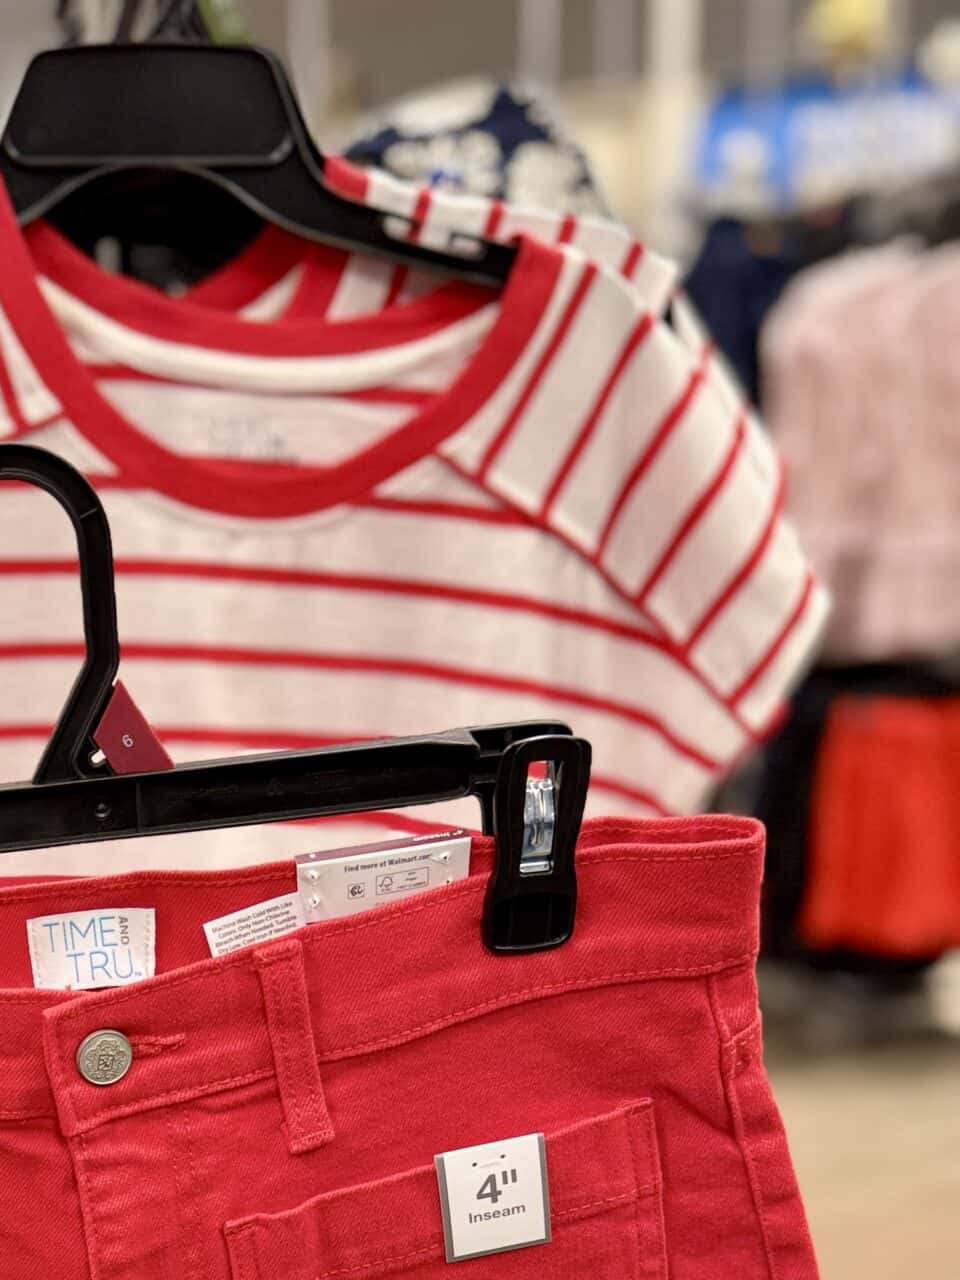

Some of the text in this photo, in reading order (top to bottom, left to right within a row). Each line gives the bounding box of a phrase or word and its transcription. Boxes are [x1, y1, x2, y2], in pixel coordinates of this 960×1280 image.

[121, 734, 134, 748] 6
[344, 864, 359, 873] Find
[360, 862, 378, 871] more
[379, 860, 387, 869] at
[118, 916, 130, 945] AND
[212, 920, 236, 933] Machine
[236, 915, 251, 926] Wash
[251, 910, 266, 920] Cold
[42, 916, 118, 952] TIME
[476, 1168, 518, 1204] 4"
[468, 1204, 526, 1224] Inseam
